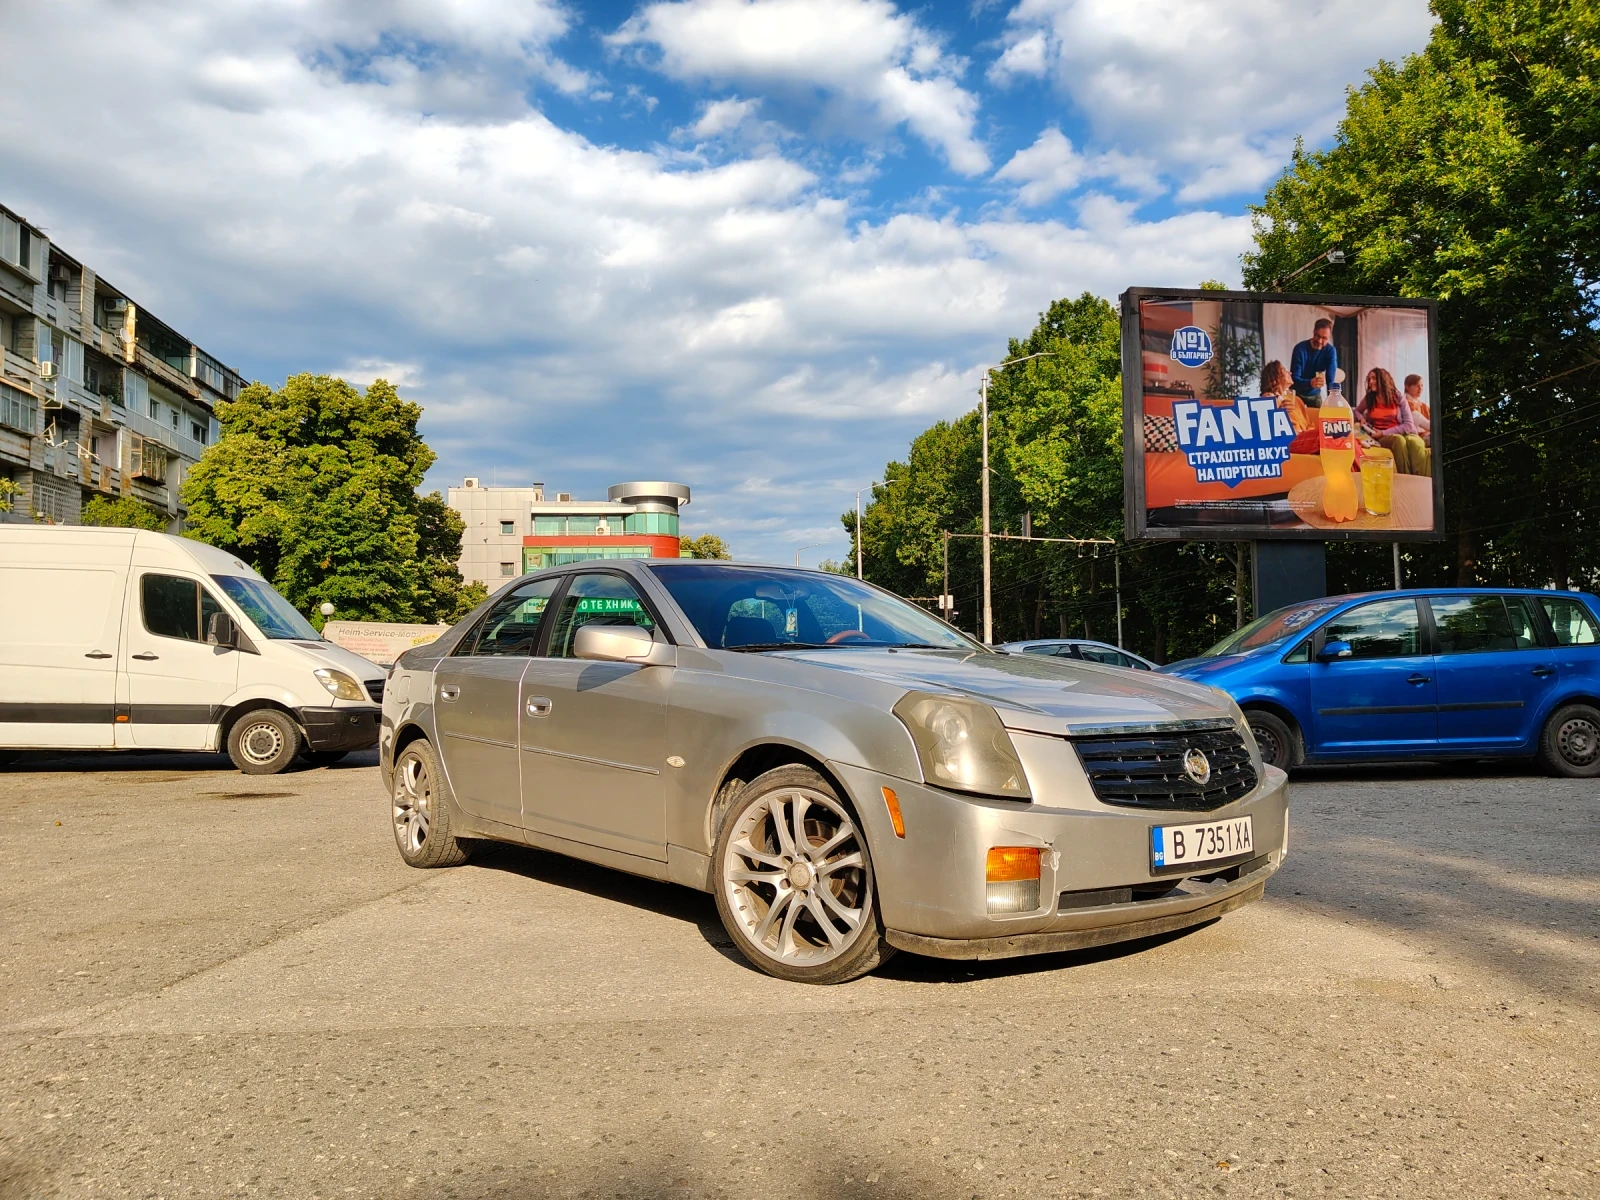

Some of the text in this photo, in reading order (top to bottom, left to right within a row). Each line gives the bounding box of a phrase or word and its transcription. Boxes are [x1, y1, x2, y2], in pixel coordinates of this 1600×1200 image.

[1172, 351, 1177, 359] В
[1174, 399, 1294, 447] FANTA
[1322, 420, 1352, 434] FANTA
[1188, 446, 1289, 465] СТРАХОТЕН ВКУС
[1197, 463, 1281, 481] НА ПОРТОКАЛ
[578, 599, 641, 610] ОТЕХНИК
[1173, 821, 1251, 860] B 7351 XA
